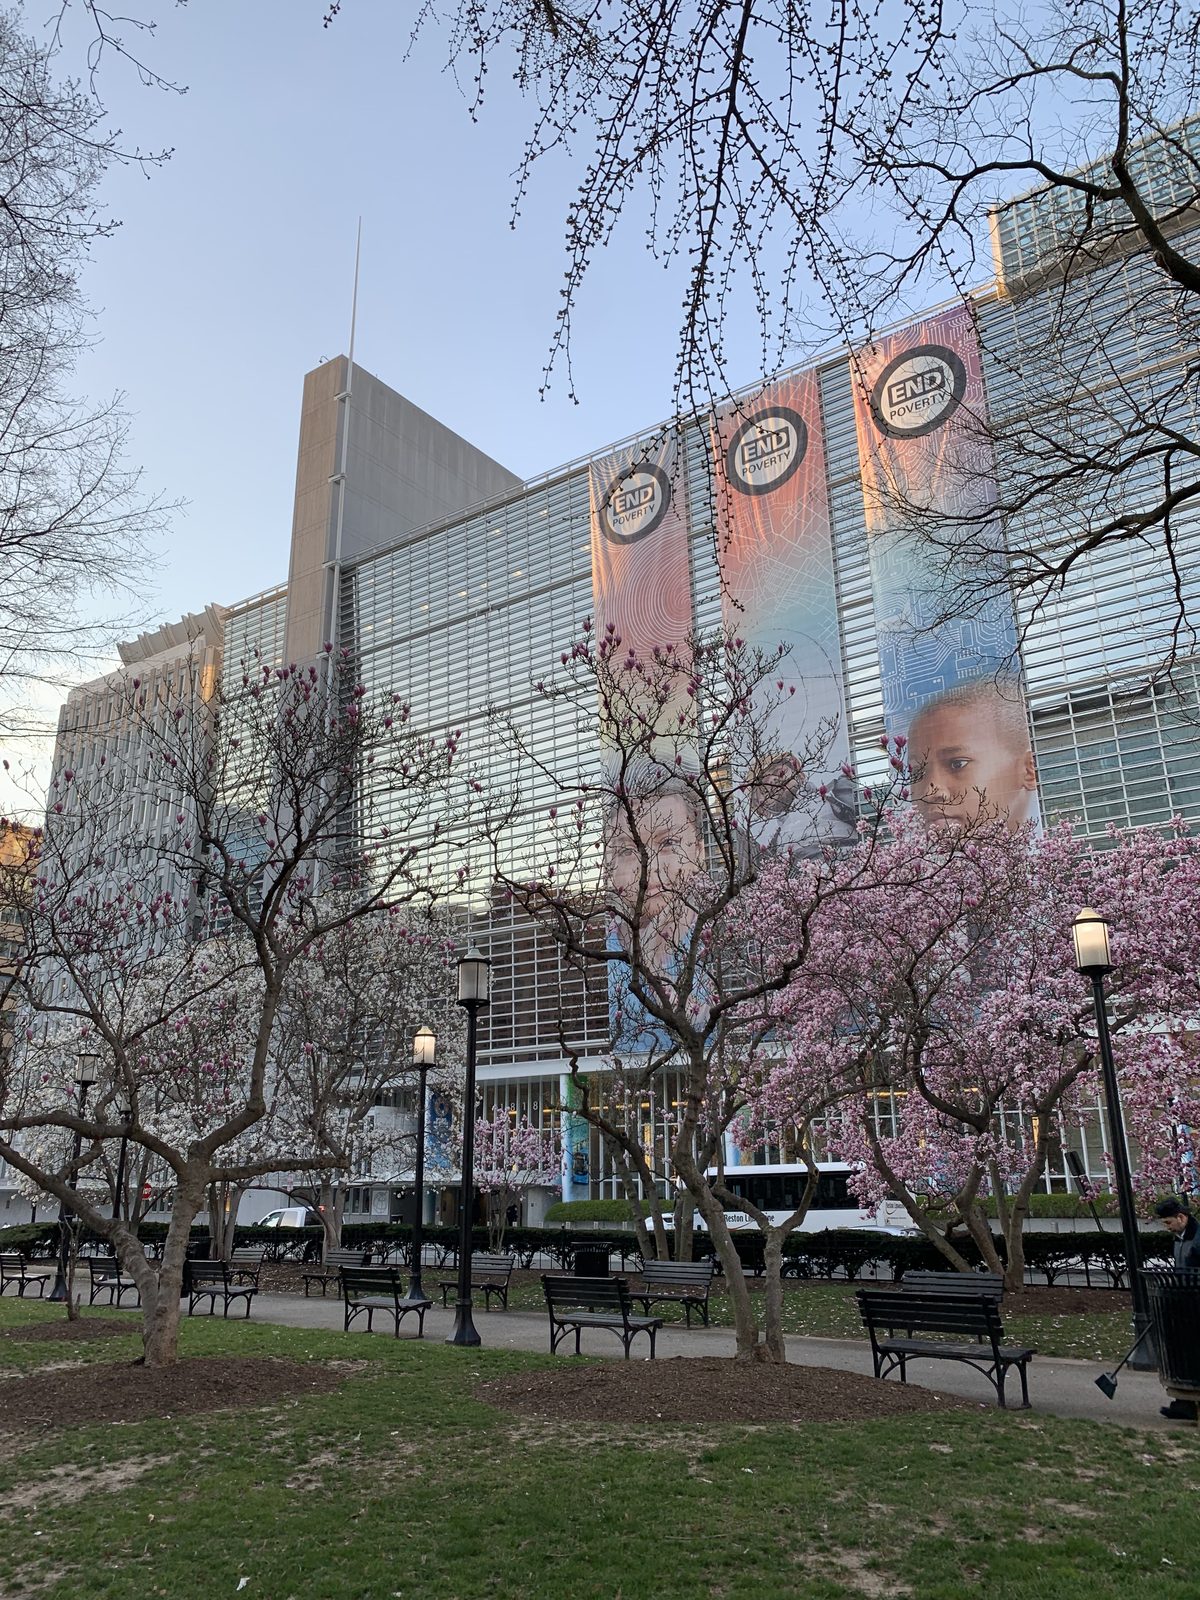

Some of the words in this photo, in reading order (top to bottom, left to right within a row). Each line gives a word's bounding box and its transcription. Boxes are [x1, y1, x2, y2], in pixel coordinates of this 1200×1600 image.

[891, 371, 942, 404] END
[889, 392, 947, 420] POVERTY
[743, 431, 788, 463] END
[742, 450, 791, 476] POVERTY
[615, 486, 653, 513] END
[612, 503, 655, 527] POVERTY
